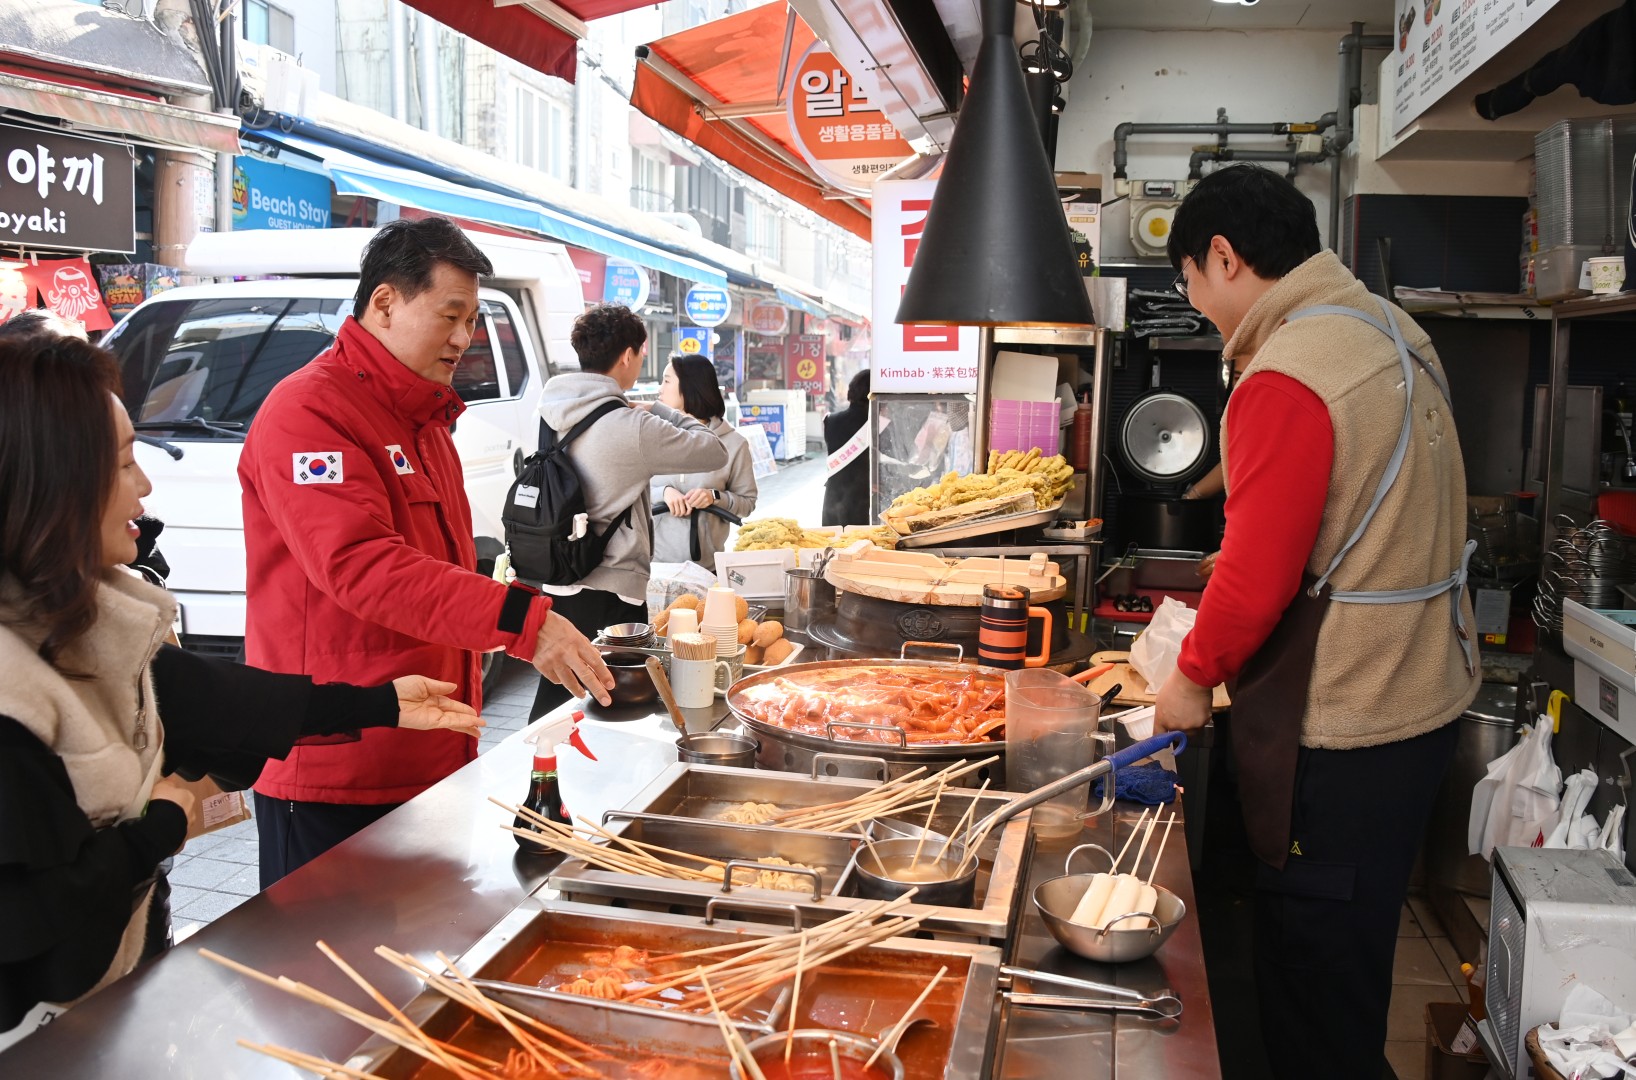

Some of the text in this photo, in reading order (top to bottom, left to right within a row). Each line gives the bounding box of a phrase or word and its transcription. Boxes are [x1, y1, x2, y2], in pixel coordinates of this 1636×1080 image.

[251, 188, 329, 229] Beach Stay
[268, 216, 292, 230] GUEST
[611, 274, 639, 287] 31cm
[110, 293, 138, 304] STAY
[880, 367, 925, 378] Kimbab
